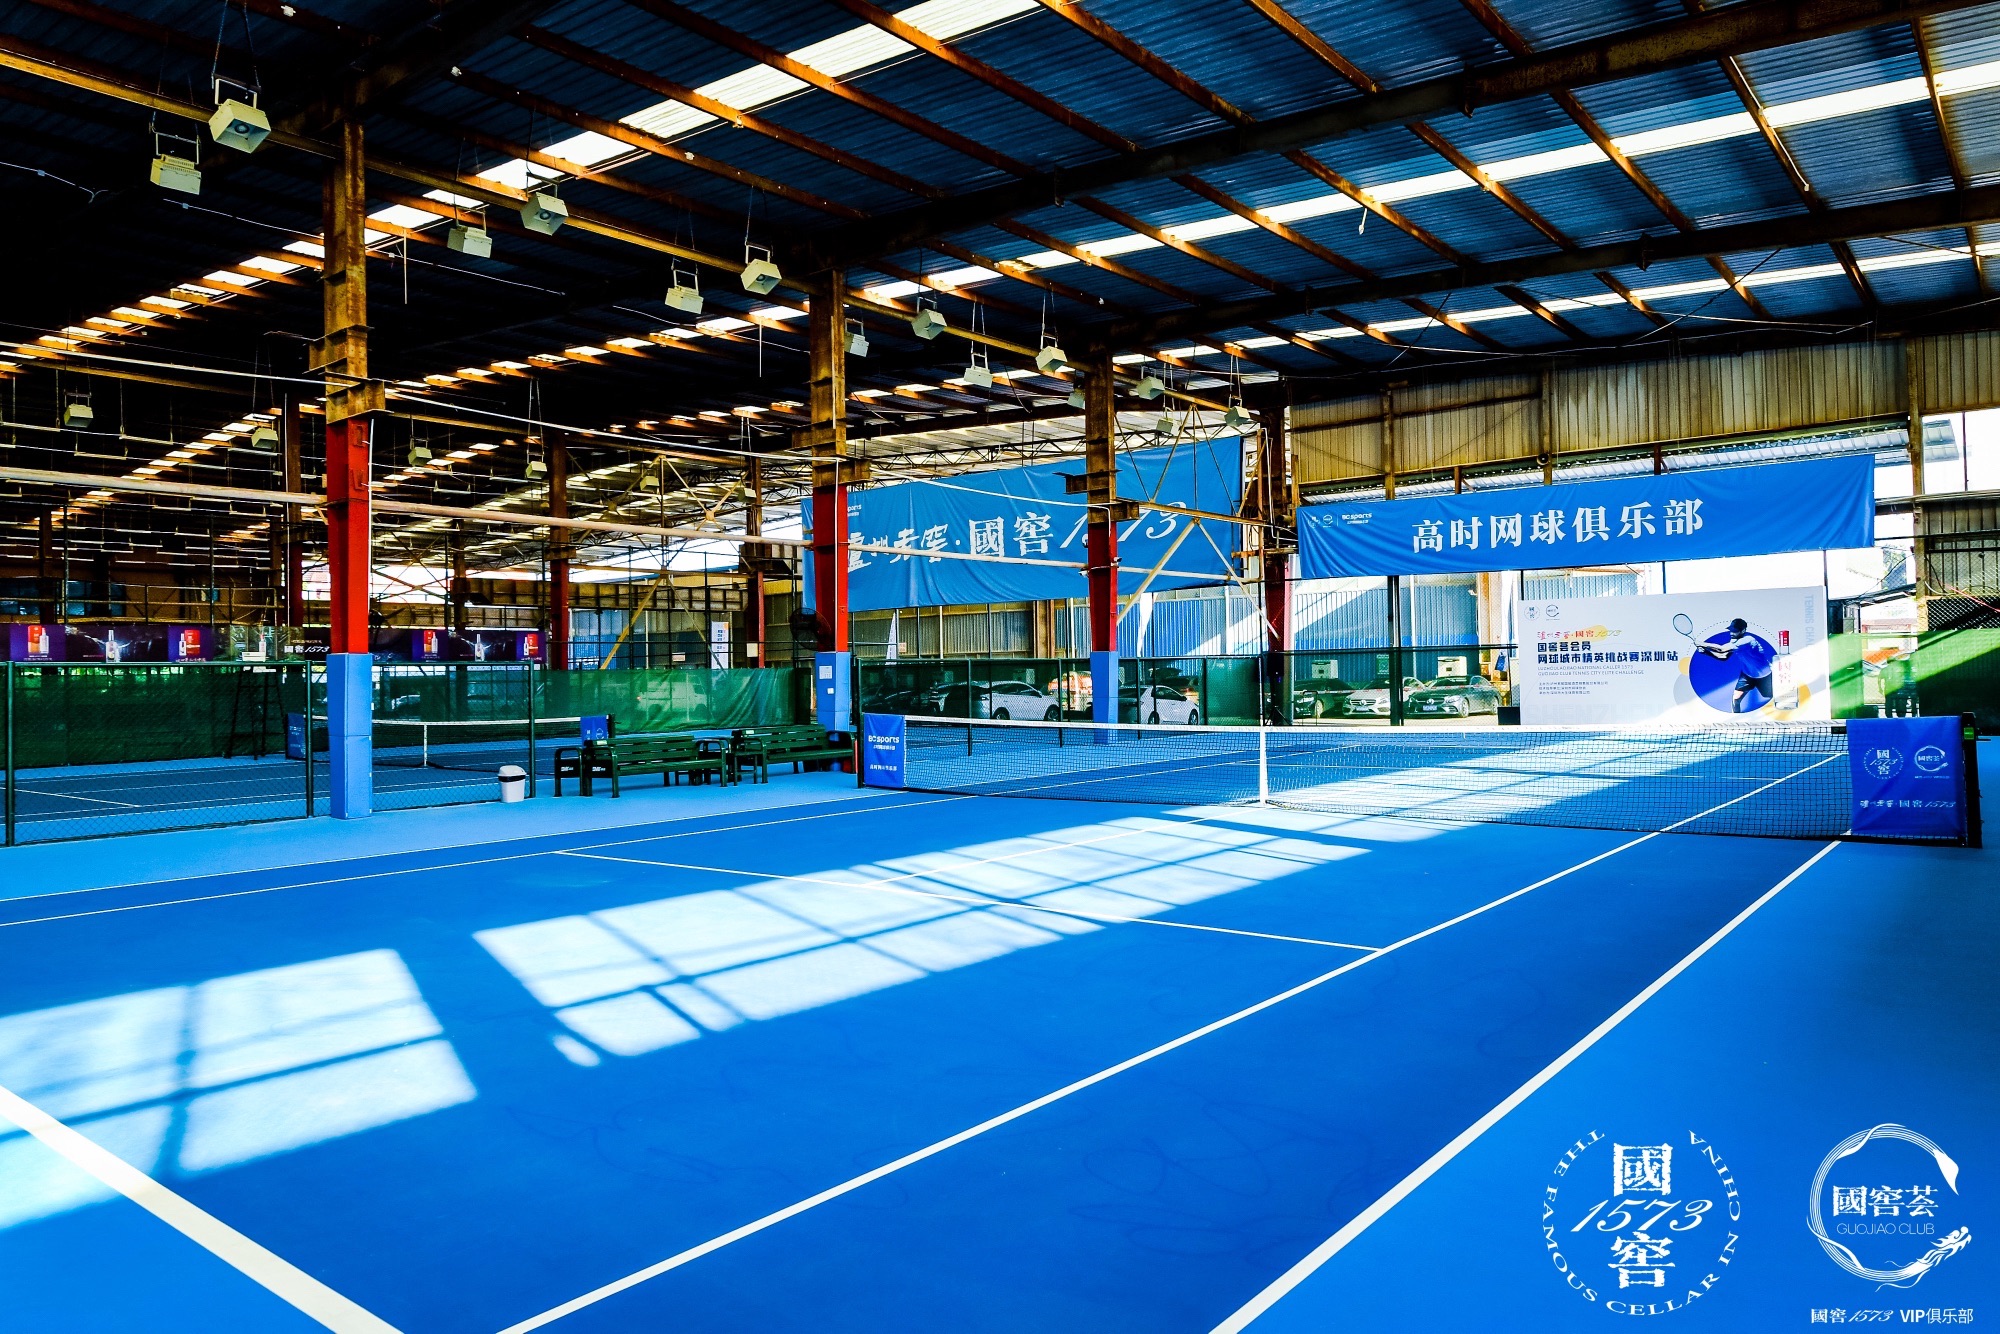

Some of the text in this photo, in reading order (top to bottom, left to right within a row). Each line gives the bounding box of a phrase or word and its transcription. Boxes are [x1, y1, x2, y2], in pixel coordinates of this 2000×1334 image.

[1411, 498, 1704, 553] 高时网球俱乐部
[1537, 650, 1679, 664] 网球城市精英挑战赛深圳站
